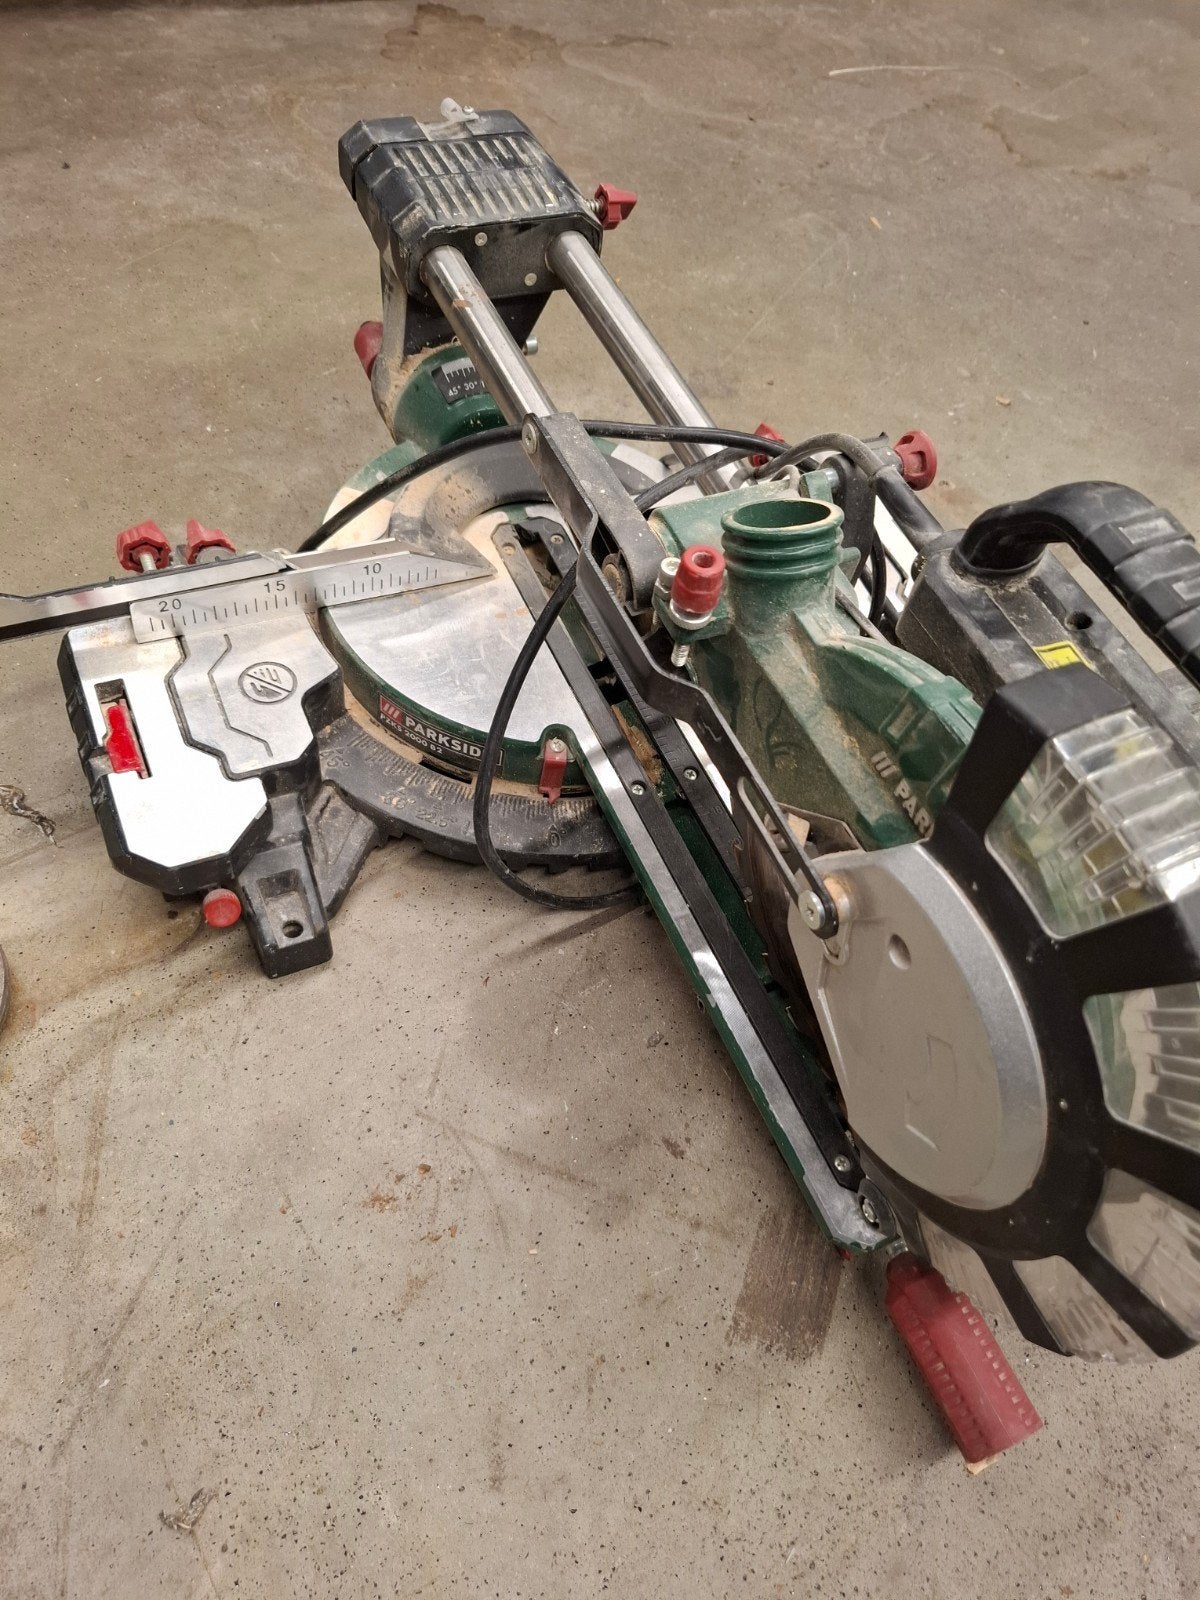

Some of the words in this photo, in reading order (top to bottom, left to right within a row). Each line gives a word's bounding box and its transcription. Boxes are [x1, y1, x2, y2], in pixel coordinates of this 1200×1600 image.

[159, 598, 182, 612] 20
[264, 580, 286, 593] 15
[363, 562, 382, 575] 10
[404, 729, 428, 747] 2000
[405, 715, 483, 757] PARKSID
